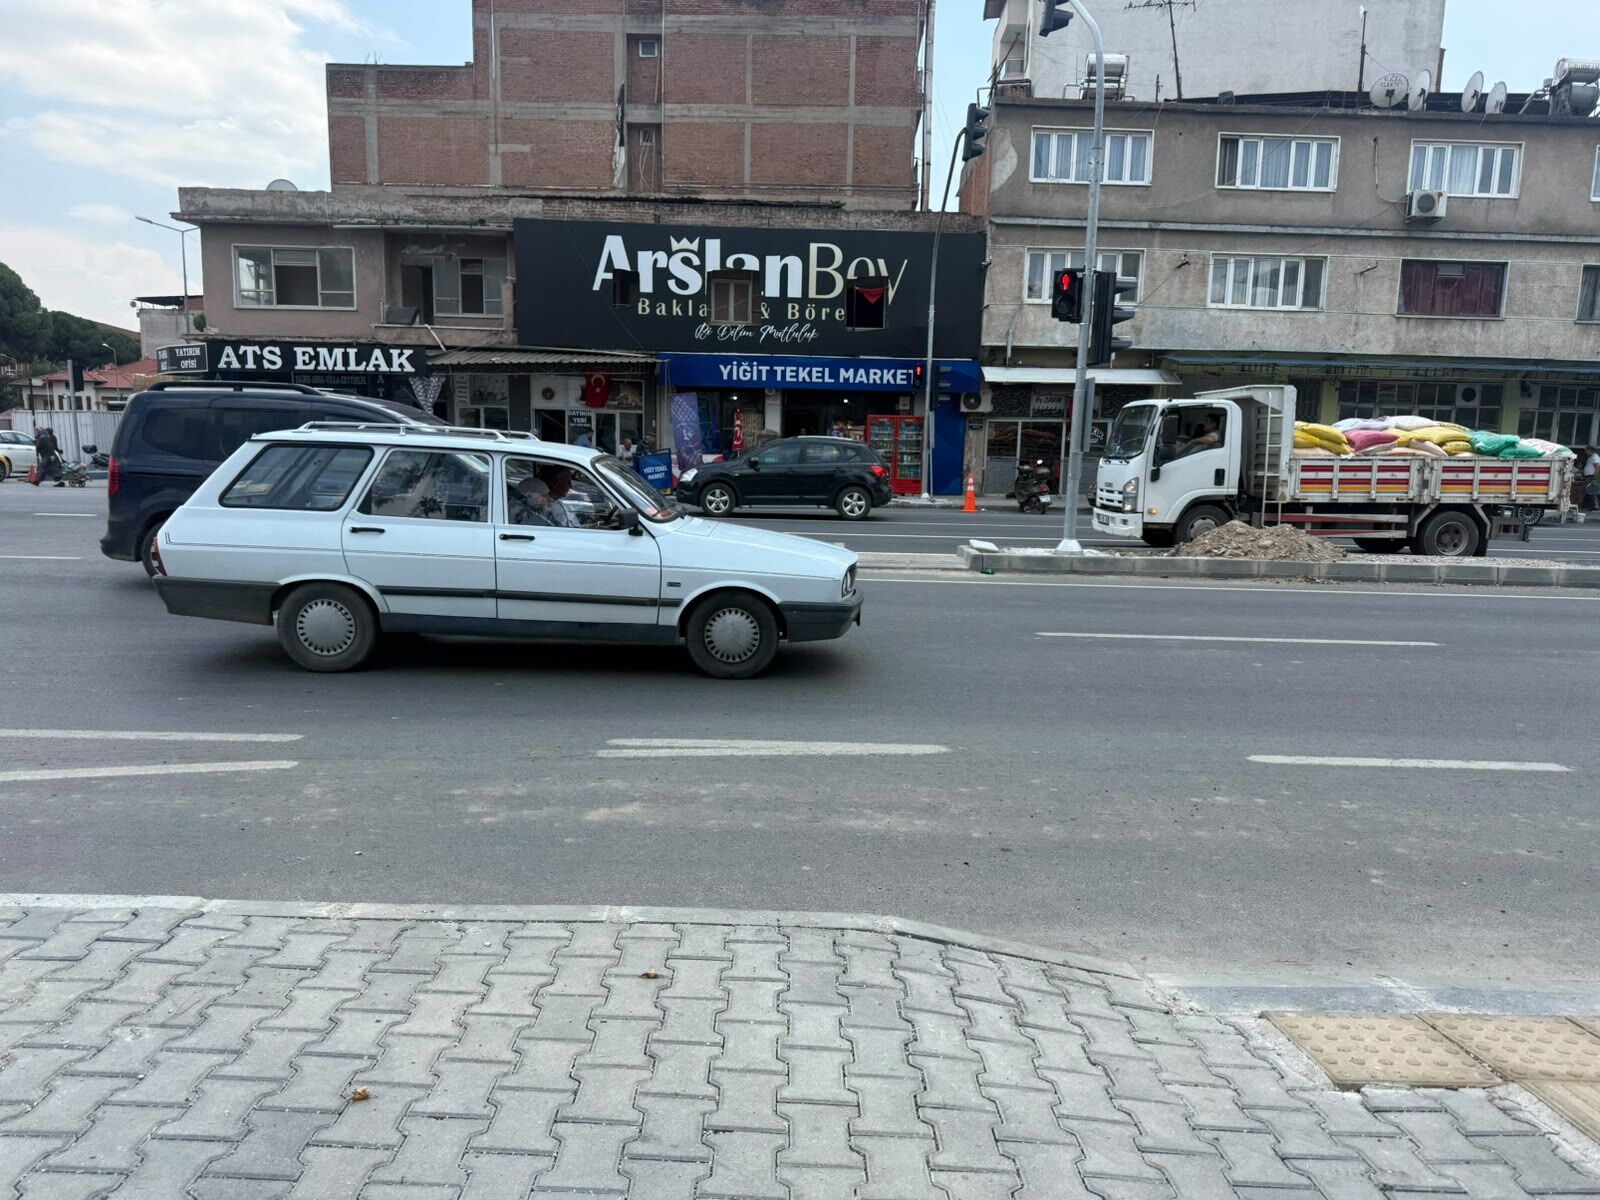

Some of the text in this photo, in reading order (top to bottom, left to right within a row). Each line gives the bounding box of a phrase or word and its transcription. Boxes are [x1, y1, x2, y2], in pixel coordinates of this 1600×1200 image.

[638, 298, 845, 320] Bakla & Böre
[717, 323, 755, 341] Dilim
[760, 323, 818, 343] Mutluluk
[174, 347, 201, 357] YATIRIM
[217, 345, 416, 373] ATS EMLAK
[180, 358, 197, 369] OFİSİ
[719, 361, 770, 381] YİĞİT
[773, 366, 835, 383] TEKEL
